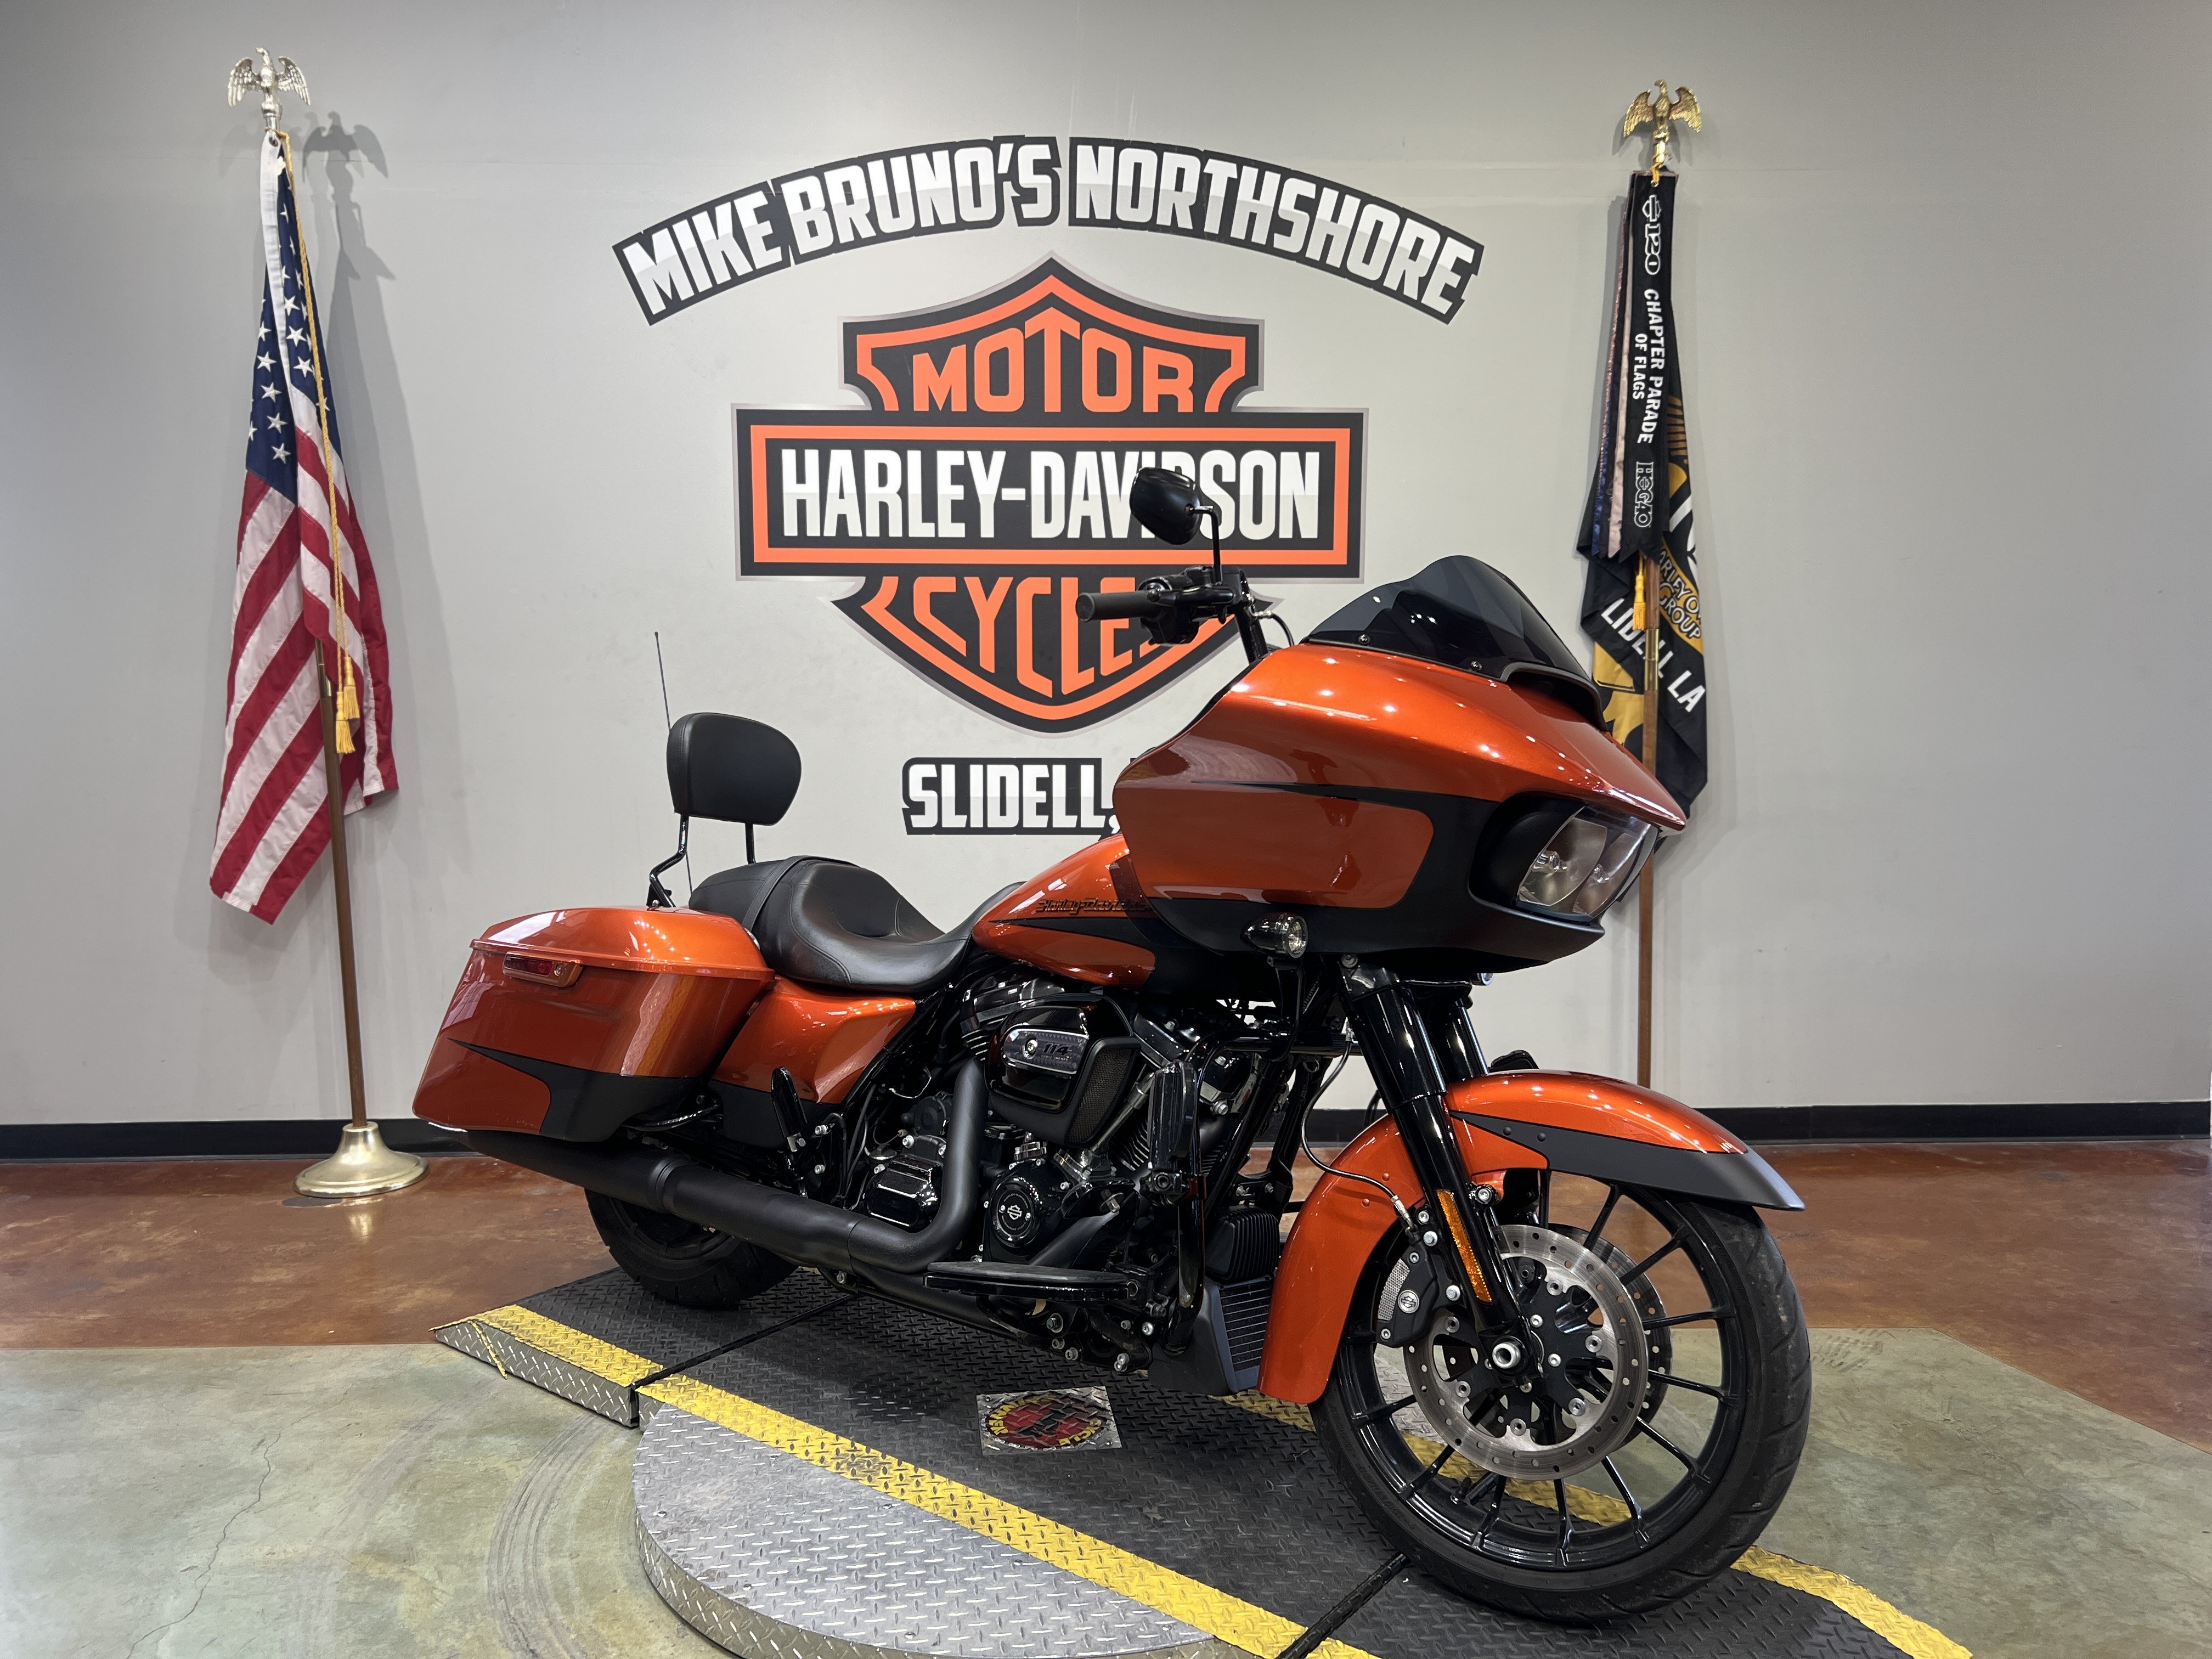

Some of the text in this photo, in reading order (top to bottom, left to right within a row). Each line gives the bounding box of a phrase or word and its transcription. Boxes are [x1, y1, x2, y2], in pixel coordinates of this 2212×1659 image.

[622, 142, 1476, 315] MIKE BRUNO'S NORTHSHORE
[912, 307, 1194, 413] MOTOR
[1632, 334, 1647, 399] OF FLAGS
[1637, 289, 1665, 443] CHAPTER PARADE
[781, 449, 1320, 540] HARLEY-DAVSON
[913, 577, 1160, 698] CYCLE
[1659, 582, 1701, 639] GROUP
[1667, 670, 1706, 713] LA
[1042, 1042, 1073, 1056] 114
